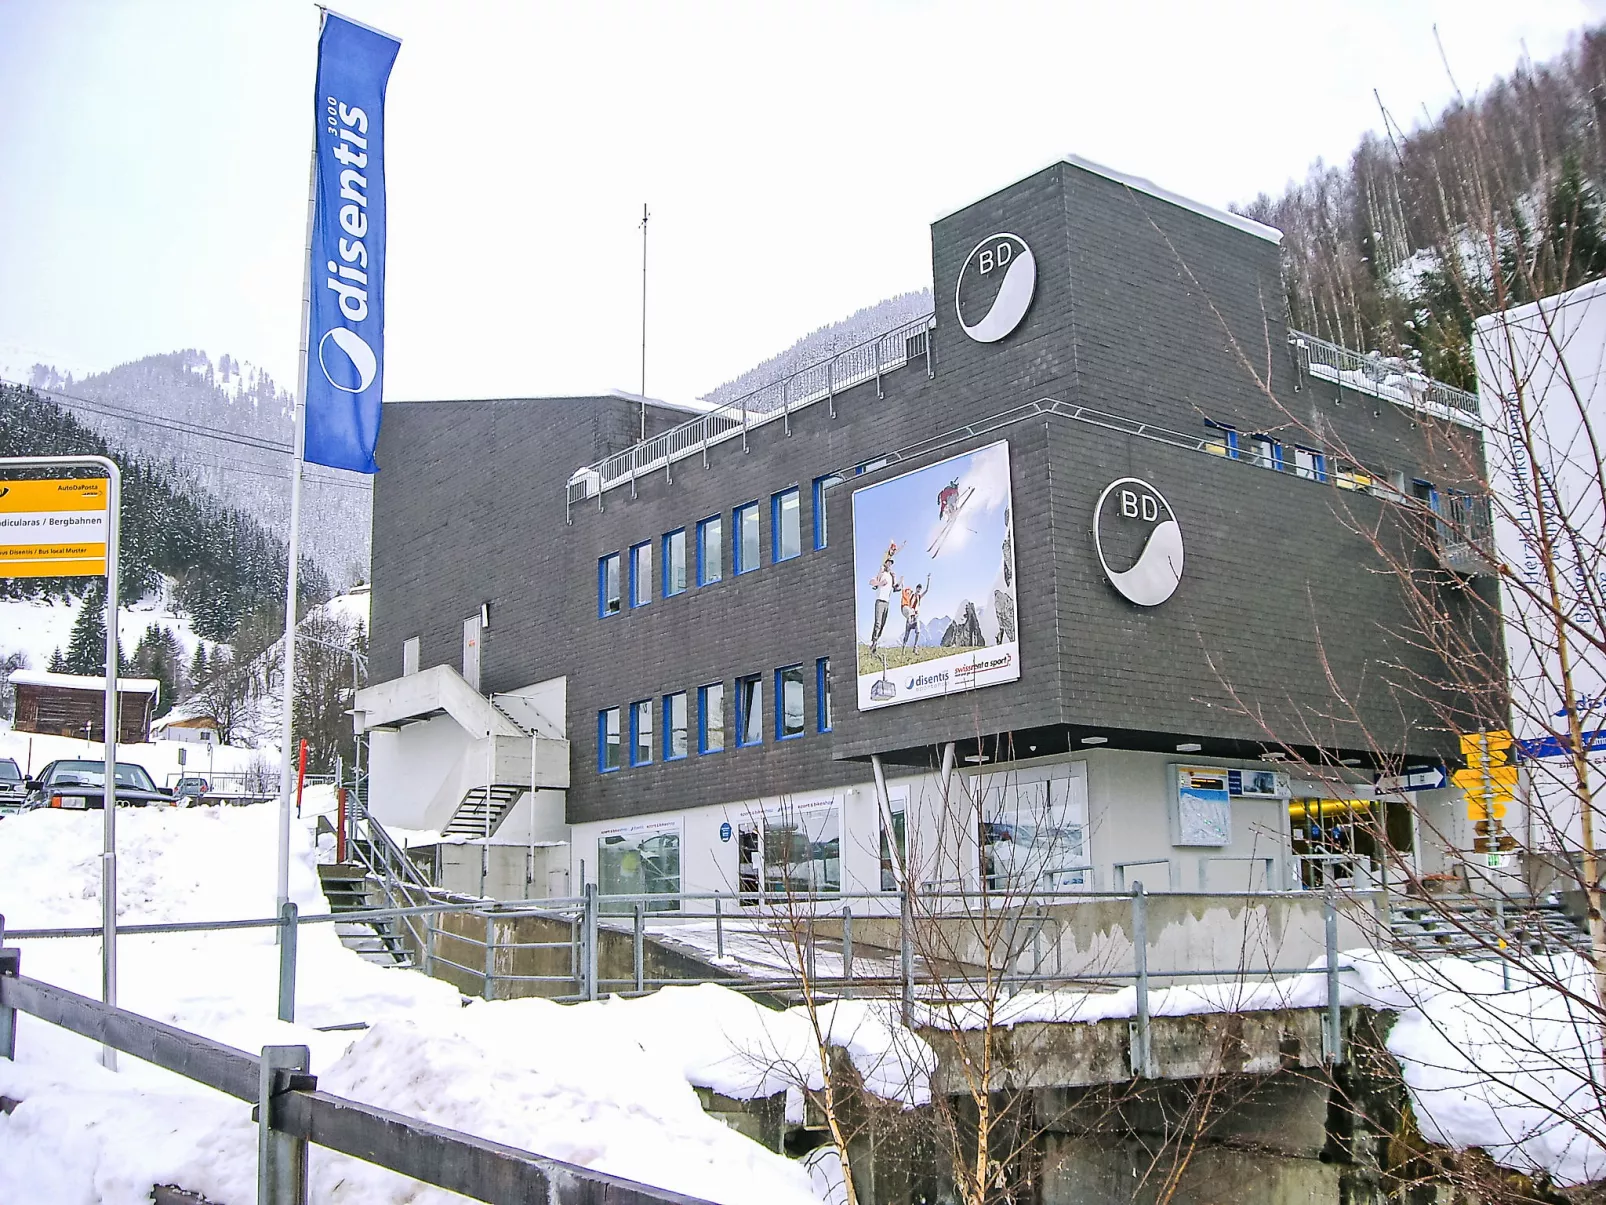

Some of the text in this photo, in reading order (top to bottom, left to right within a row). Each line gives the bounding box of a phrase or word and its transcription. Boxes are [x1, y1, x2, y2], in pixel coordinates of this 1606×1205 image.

[327, 96, 338, 137] 3000
[327, 101, 369, 323] disentis
[979, 242, 1012, 275] BD
[57, 484, 99, 492] AutoDaPosta
[1121, 485, 1159, 522] BD
[49, 516, 103, 527] Bergbahnen
[989, 655, 1007, 668] sport
[915, 672, 949, 687] disentis
